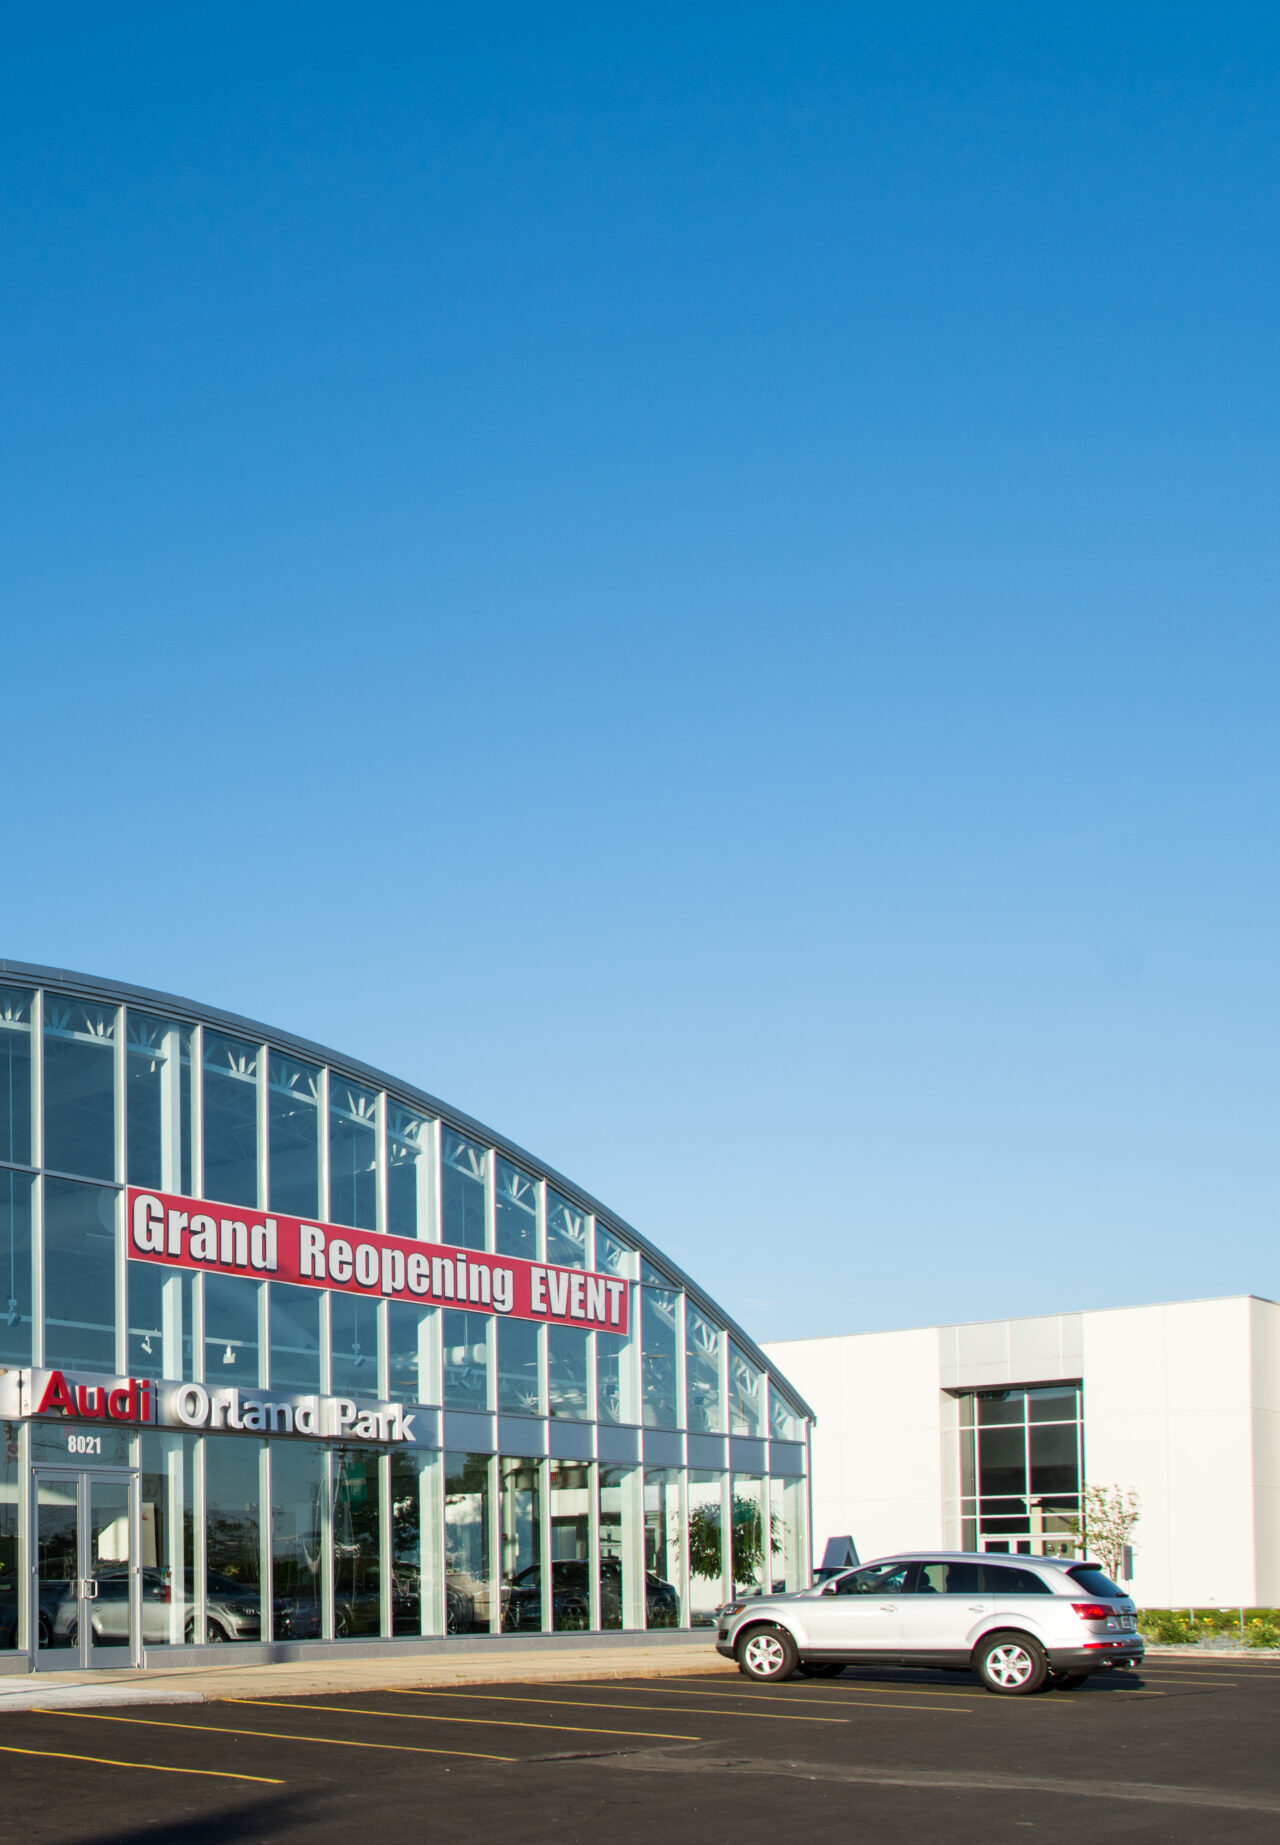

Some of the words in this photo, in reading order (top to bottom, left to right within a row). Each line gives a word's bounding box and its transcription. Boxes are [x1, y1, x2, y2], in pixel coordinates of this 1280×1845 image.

[133, 1194, 278, 1271] Grand
[299, 1225, 514, 1312] Reopening
[531, 1267, 624, 1325] EVENT
[38, 1371, 150, 1421] Audi
[176, 1383, 318, 1435] Orland
[329, 1397, 416, 1441] Park
[67, 1435, 101, 1454] 8021
